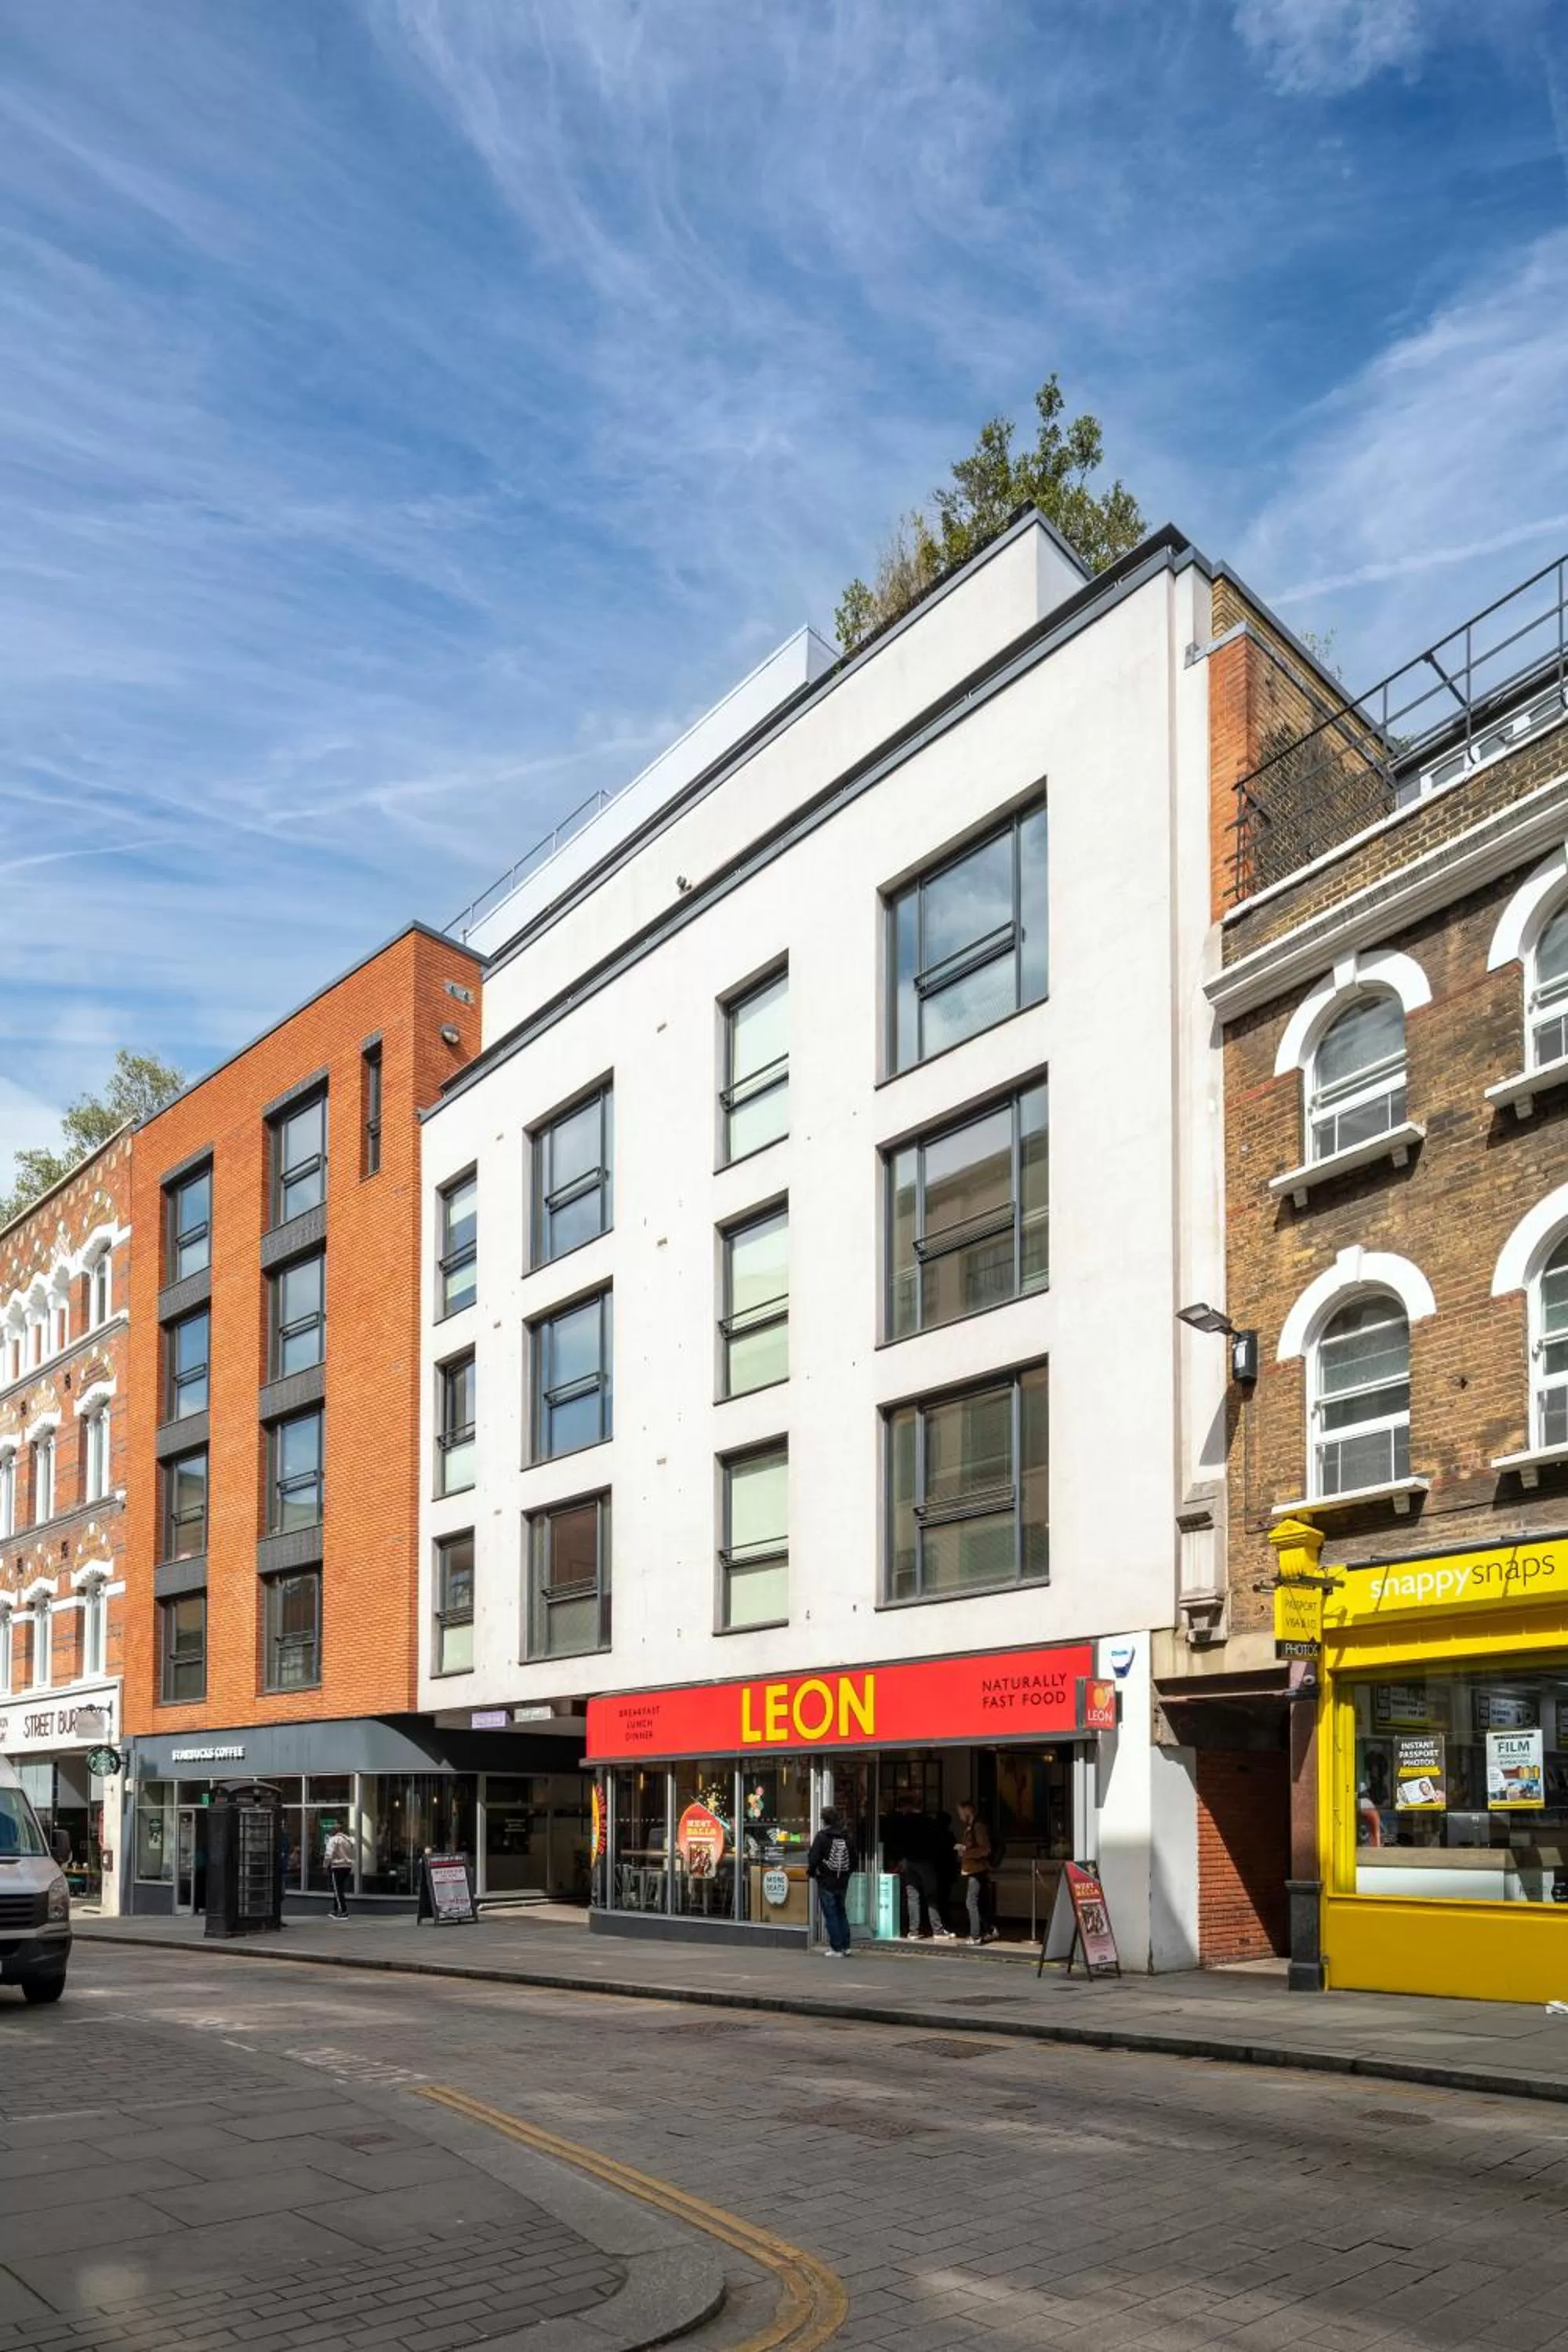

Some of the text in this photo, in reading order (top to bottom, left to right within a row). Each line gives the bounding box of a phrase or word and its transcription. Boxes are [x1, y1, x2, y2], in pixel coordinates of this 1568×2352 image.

[1285, 1642, 1319, 1657] PHOTOS
[982, 1672, 1067, 1693] NATURALLY
[982, 1691, 1066, 1709] FAST FOOD
[742, 1674, 875, 1744] LEON
[1087, 1709, 1112, 1723] LEON
[23, 1711, 55, 1739] STREET
[215, 1744, 246, 1760] COFFEE
[1401, 1740, 1434, 1750] INSTANT
[1497, 1740, 1530, 1753] FILM
[1398, 1749, 1440, 1759] PASSPORT
